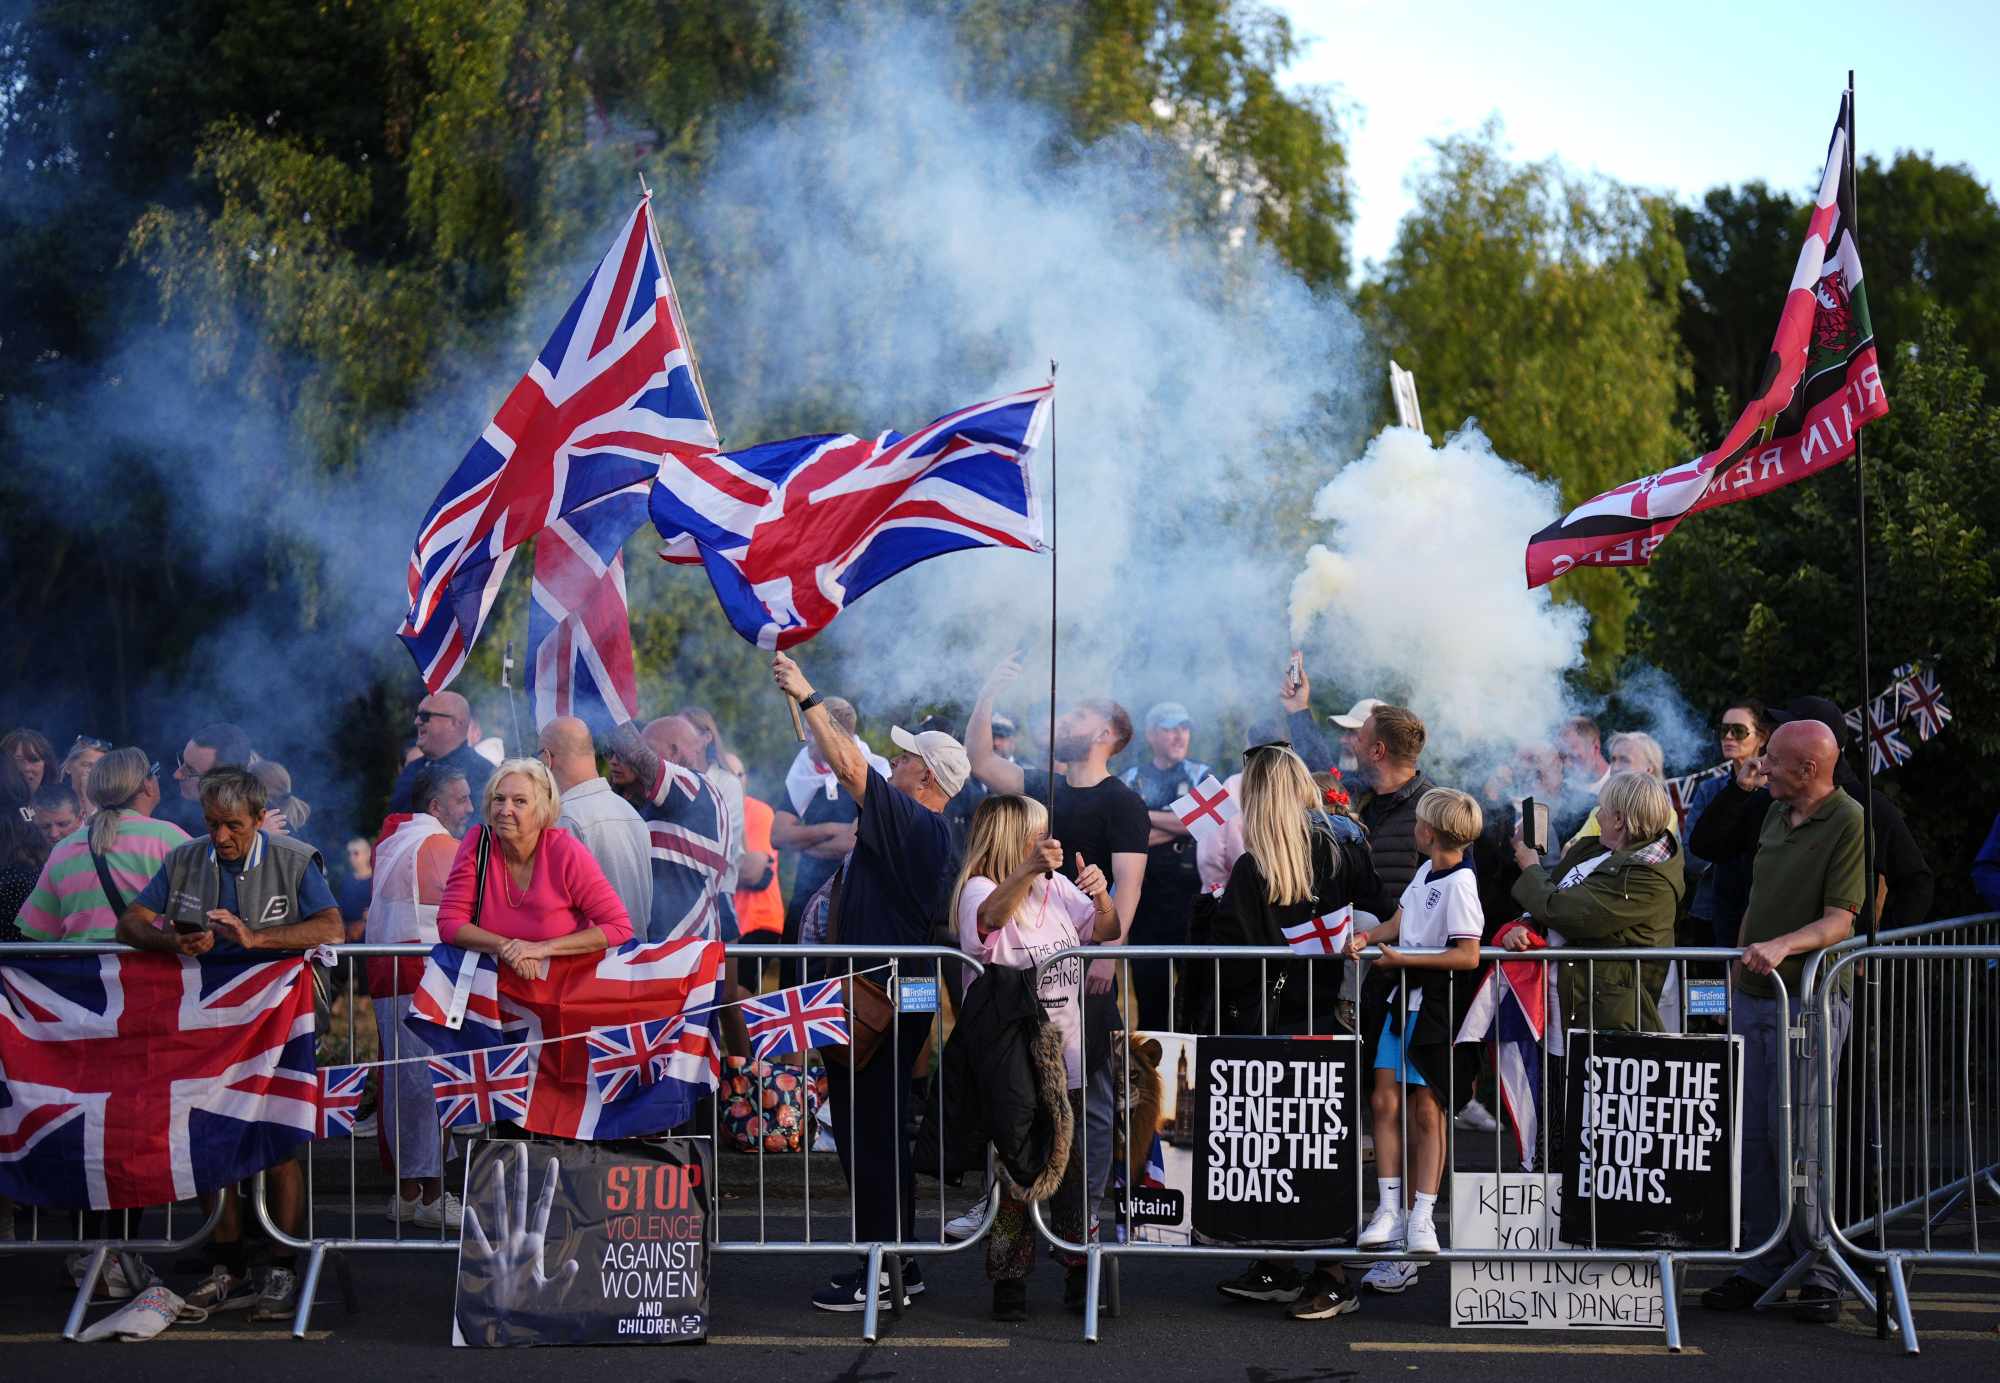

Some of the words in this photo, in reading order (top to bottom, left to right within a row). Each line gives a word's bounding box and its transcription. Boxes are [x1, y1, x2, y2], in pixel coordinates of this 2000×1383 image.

[1040, 968, 1079, 990] PPING
[1209, 1059, 1284, 1097] STOP
[1289, 1061, 1345, 1098] THE
[1583, 1055, 1659, 1096] STOP
[1665, 1059, 1720, 1099] THE
[1209, 1096, 1348, 1140] BENEFITS,
[1582, 1092, 1722, 1142] BENEFITS,
[1208, 1131, 1280, 1168] STOP
[1285, 1133, 1339, 1169] THE
[1579, 1127, 1653, 1167] STOP
[1657, 1133, 1712, 1171] THE
[606, 1164, 701, 1211] STOP
[1207, 1167, 1300, 1203] BOATS.
[1480, 1184, 1545, 1215] KEIR
[1577, 1164, 1672, 1204] BOATS.
[605, 1215, 701, 1240] VIOLENCE
[1494, 1227, 1554, 1250] YOU
[602, 1242, 699, 1269] AGAINST
[602, 1271, 698, 1298] WOMEN
[1472, 1261, 1604, 1289] PUTTING
[637, 1301, 662, 1317] AND
[1455, 1287, 1527, 1321] GIRLS
[1531, 1290, 1557, 1319] IN
[1566, 1292, 1665, 1325] DANGER
[618, 1319, 678, 1334] CHILDREN
